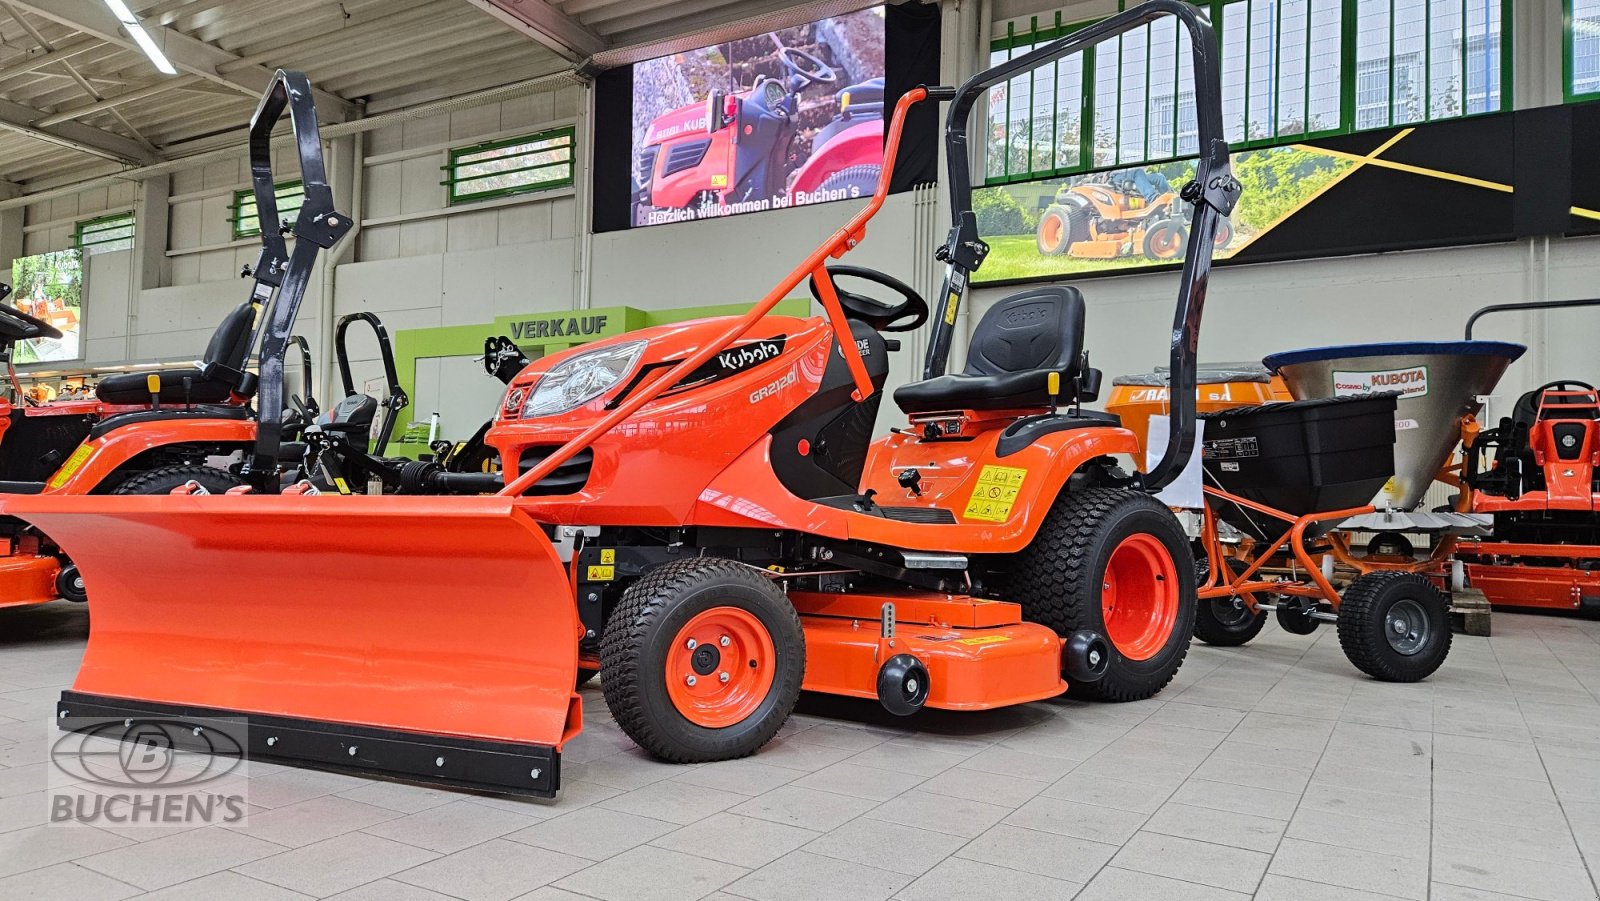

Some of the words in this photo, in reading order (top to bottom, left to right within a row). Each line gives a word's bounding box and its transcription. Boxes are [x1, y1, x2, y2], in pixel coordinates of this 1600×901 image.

[684, 117, 707, 131] KUB
[648, 207, 694, 225] Herzlich
[697, 198, 769, 218] willkommen
[772, 193, 793, 208] bei
[510, 316, 607, 339] VERKAUF
[719, 342, 780, 369] Kubota
[750, 371, 797, 404] GR2120
[1362, 383, 1371, 392] by
[1371, 370, 1425, 386] KUBOTA
[1402, 385, 1425, 394] hland
